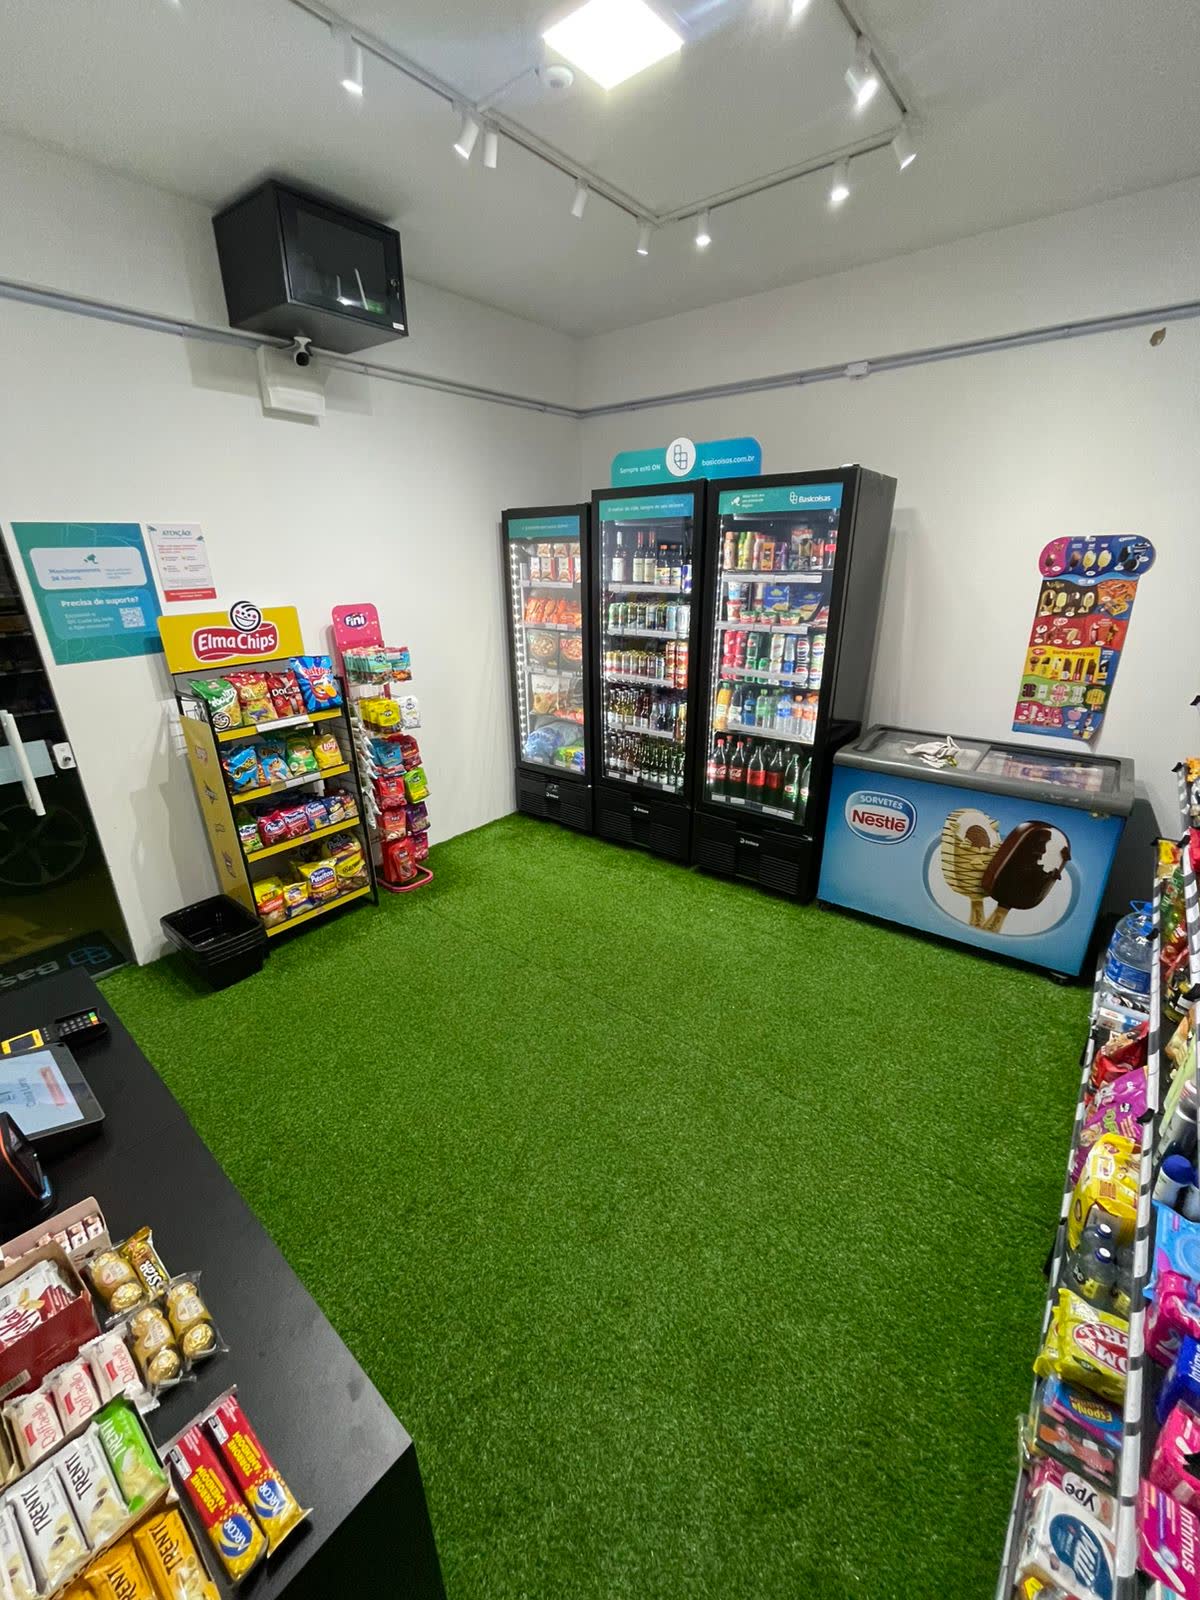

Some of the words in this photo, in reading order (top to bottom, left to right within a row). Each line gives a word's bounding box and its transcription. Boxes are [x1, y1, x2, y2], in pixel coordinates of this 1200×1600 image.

[620, 465, 639, 474] Sempre
[652, 463, 661, 471] ON
[702, 454, 755, 467] basicoisas.com.br
[799, 495, 831, 504] Basicoisas
[61, 599, 93, 608] Precisa
[105, 596, 139, 606] suporte?
[198, 633, 236, 651] Elma
[236, 633, 275, 651] Chips
[860, 795, 904, 809] SORVETES
[0, 960, 59, 988] Bas
[112, 1344, 137, 1384] Raffaello
[69, 1372, 94, 1418] Raffaello
[1070, 1401, 1113, 1423] Esponja
[32, 1402, 57, 1449] Raffaello
[227, 1441, 254, 1477] TORRONE
[233, 1431, 262, 1473] AMENDOIM
[191, 1475, 220, 1514] TORRONE
[196, 1465, 225, 1510] AMENDOIM
[259, 1481, 283, 1517] ARCOR
[224, 1518, 249, 1551] ARCOR
[1180, 1506, 1200, 1575] Intimus
[106, 1563, 138, 1600] RENT
